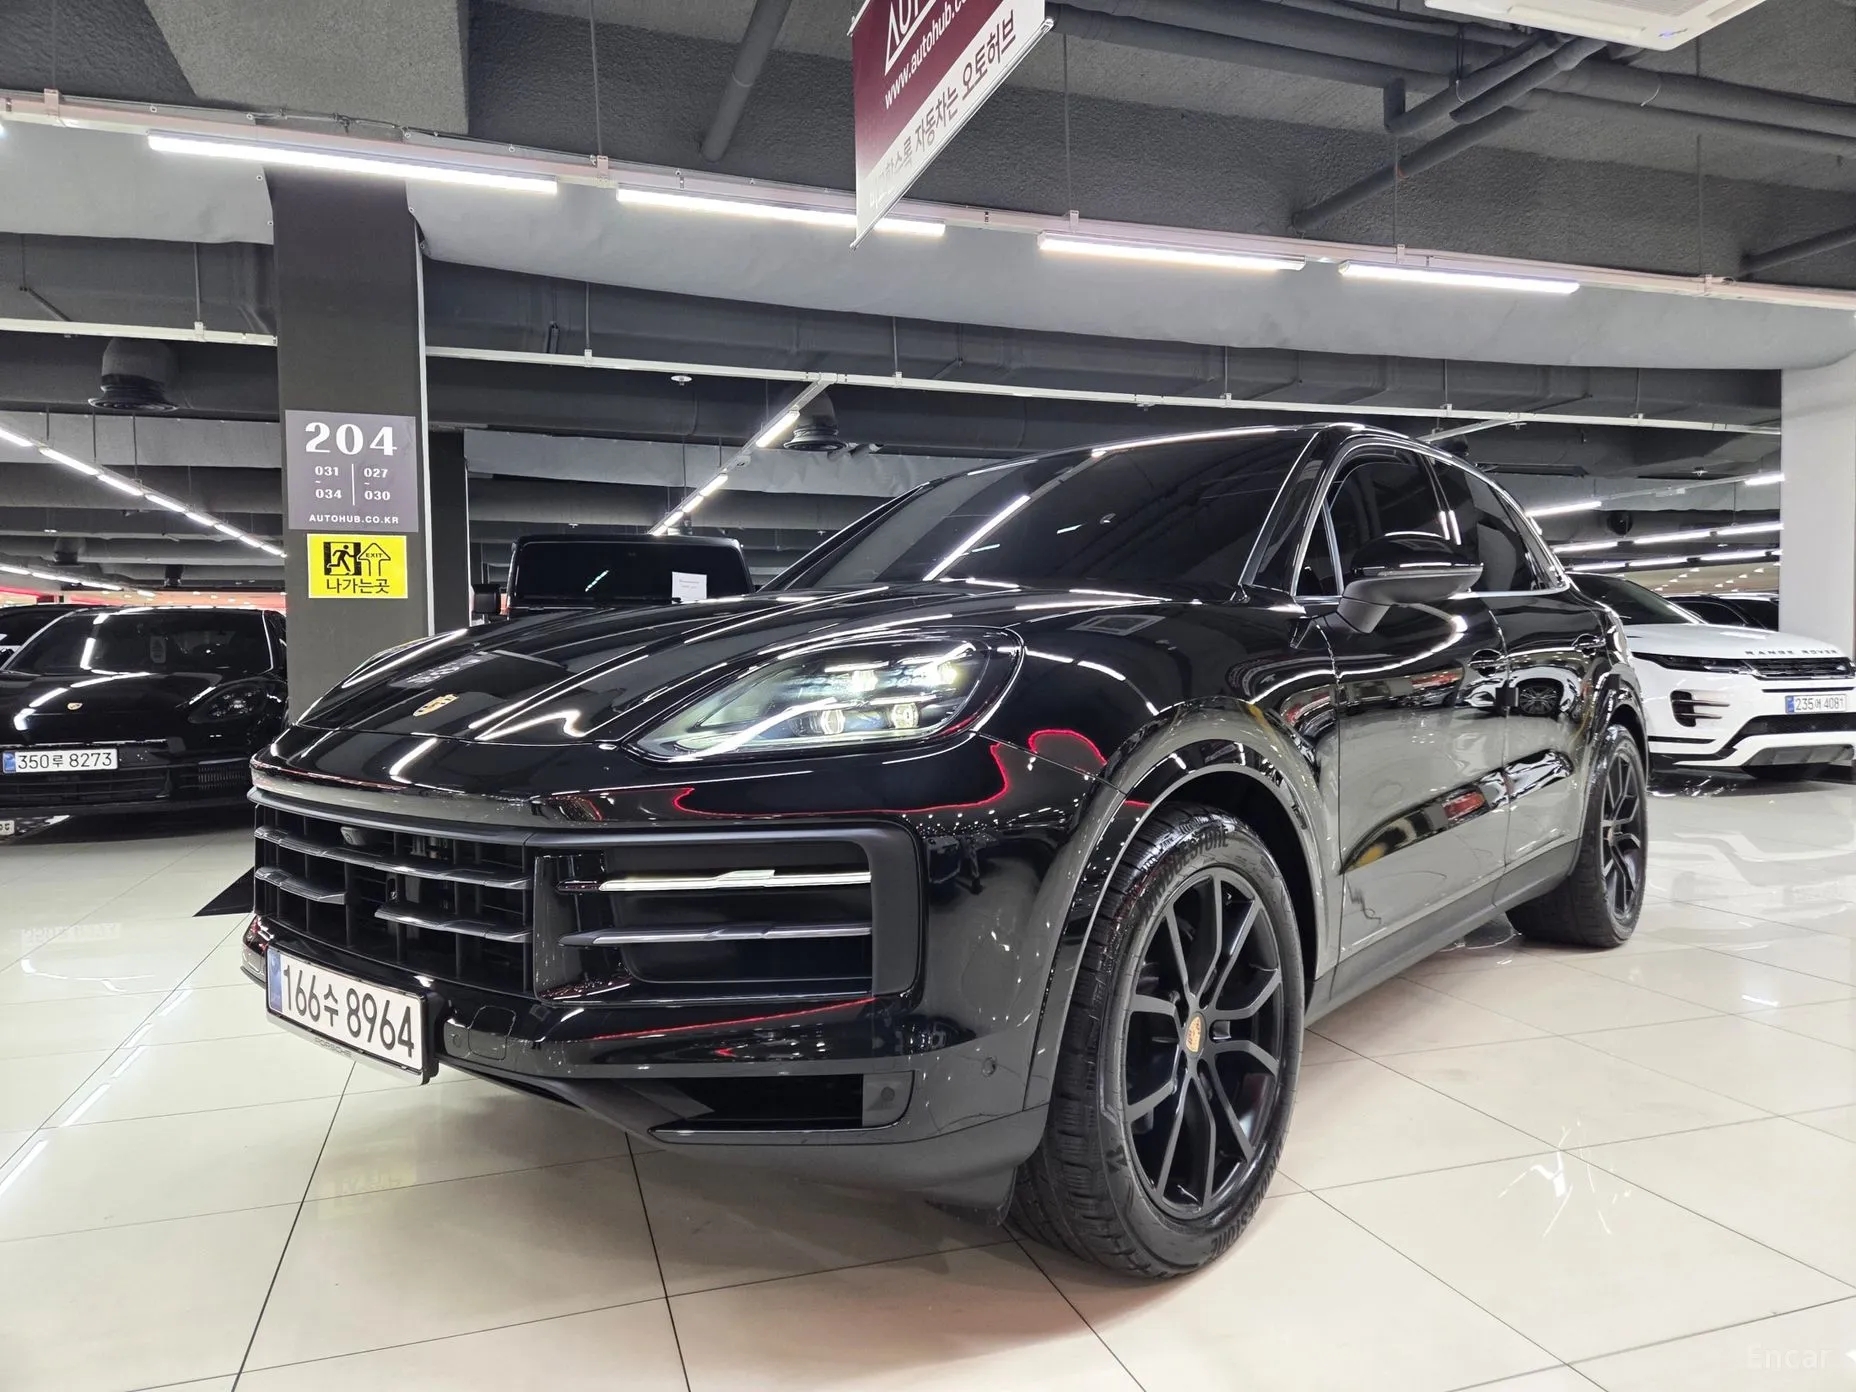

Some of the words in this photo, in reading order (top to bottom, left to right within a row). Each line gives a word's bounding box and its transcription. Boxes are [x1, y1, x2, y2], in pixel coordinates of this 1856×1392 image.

[884, 0, 967, 110] www.autohub.c
[915, 87, 959, 152] 자동차는
[962, 9, 1016, 101] 오토허브
[305, 422, 398, 456] 204
[314, 466, 339, 476] 031
[363, 468, 388, 478] 027
[315, 489, 342, 499] 034
[364, 491, 390, 501] 030
[309, 514, 399, 524] AUTOHUB.CO.KR
[326, 577, 390, 594] 나가는곳
[18, 754, 64, 770] 350루
[69, 752, 112, 768] 8273
[283, 964, 339, 1027] 166수
[346, 987, 415, 1058] 8964
